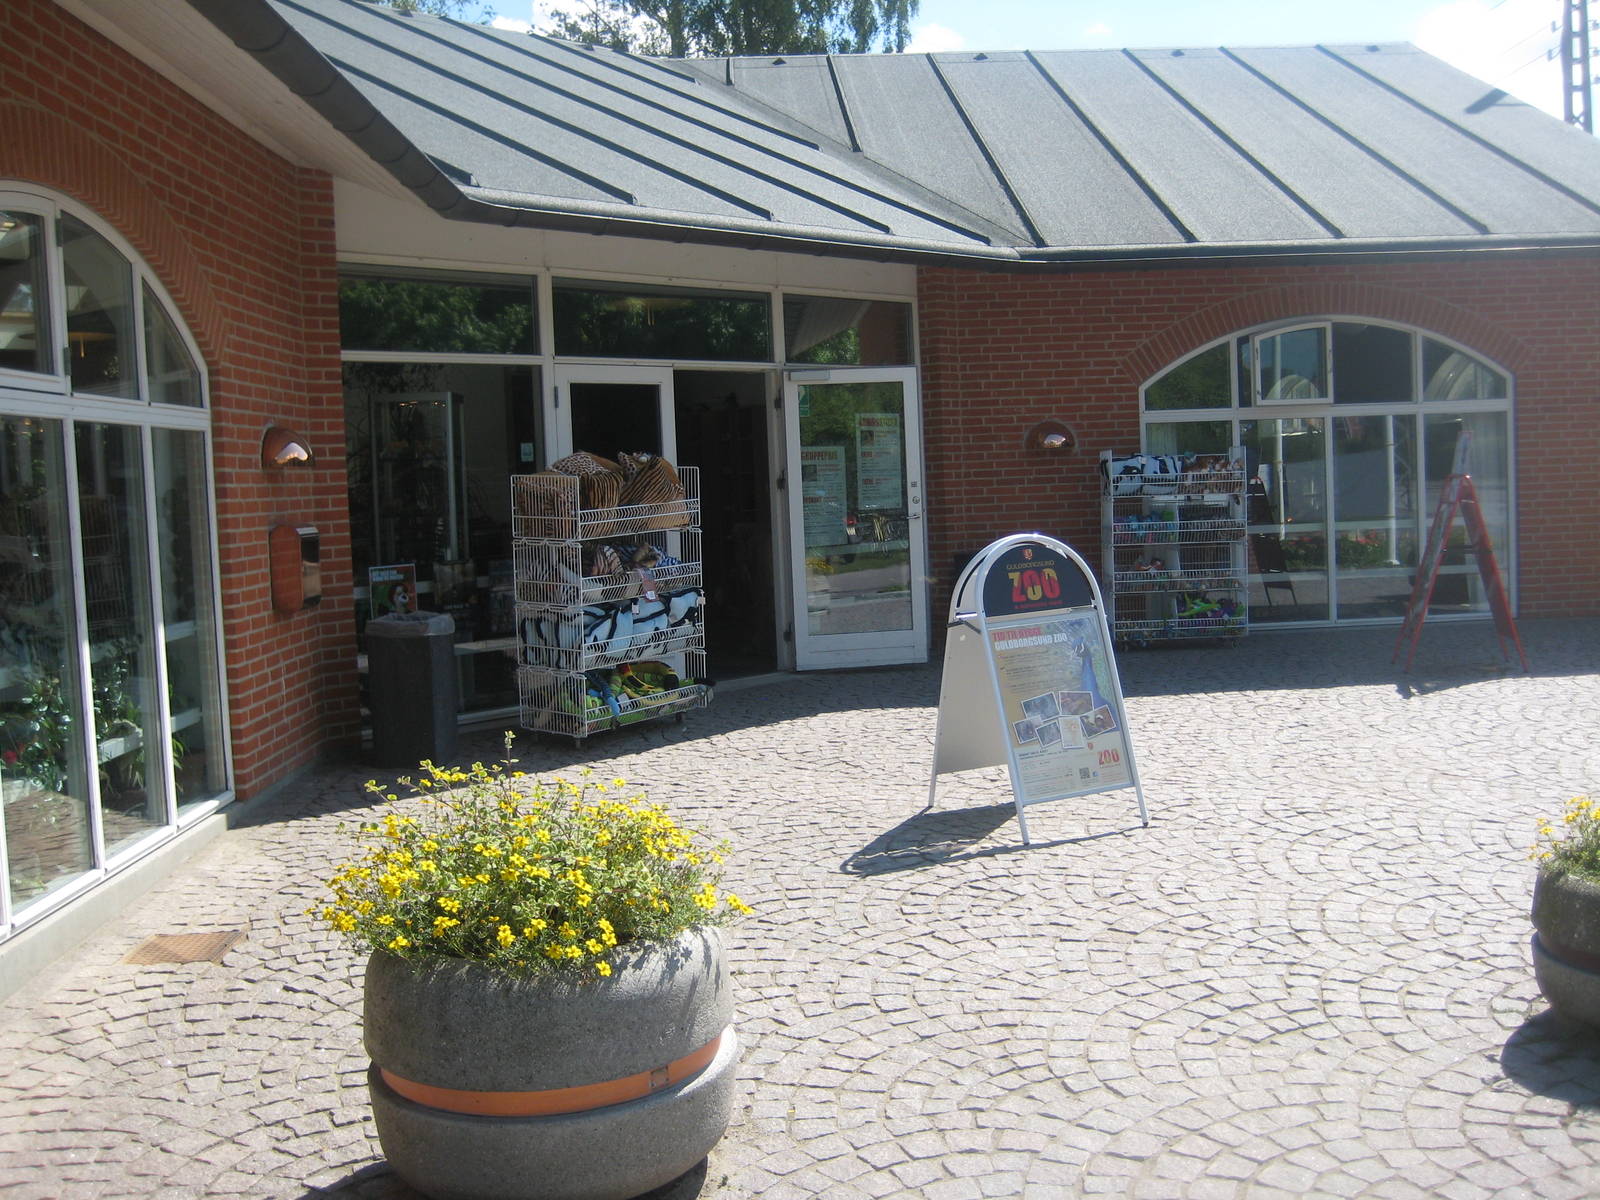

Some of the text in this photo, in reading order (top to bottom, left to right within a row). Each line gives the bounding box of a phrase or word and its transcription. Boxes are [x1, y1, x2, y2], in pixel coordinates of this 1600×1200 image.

[1008, 568, 1060, 602] ZOO
[1053, 633, 1067, 643] ZOO
[1097, 749, 1120, 765] ZOO
